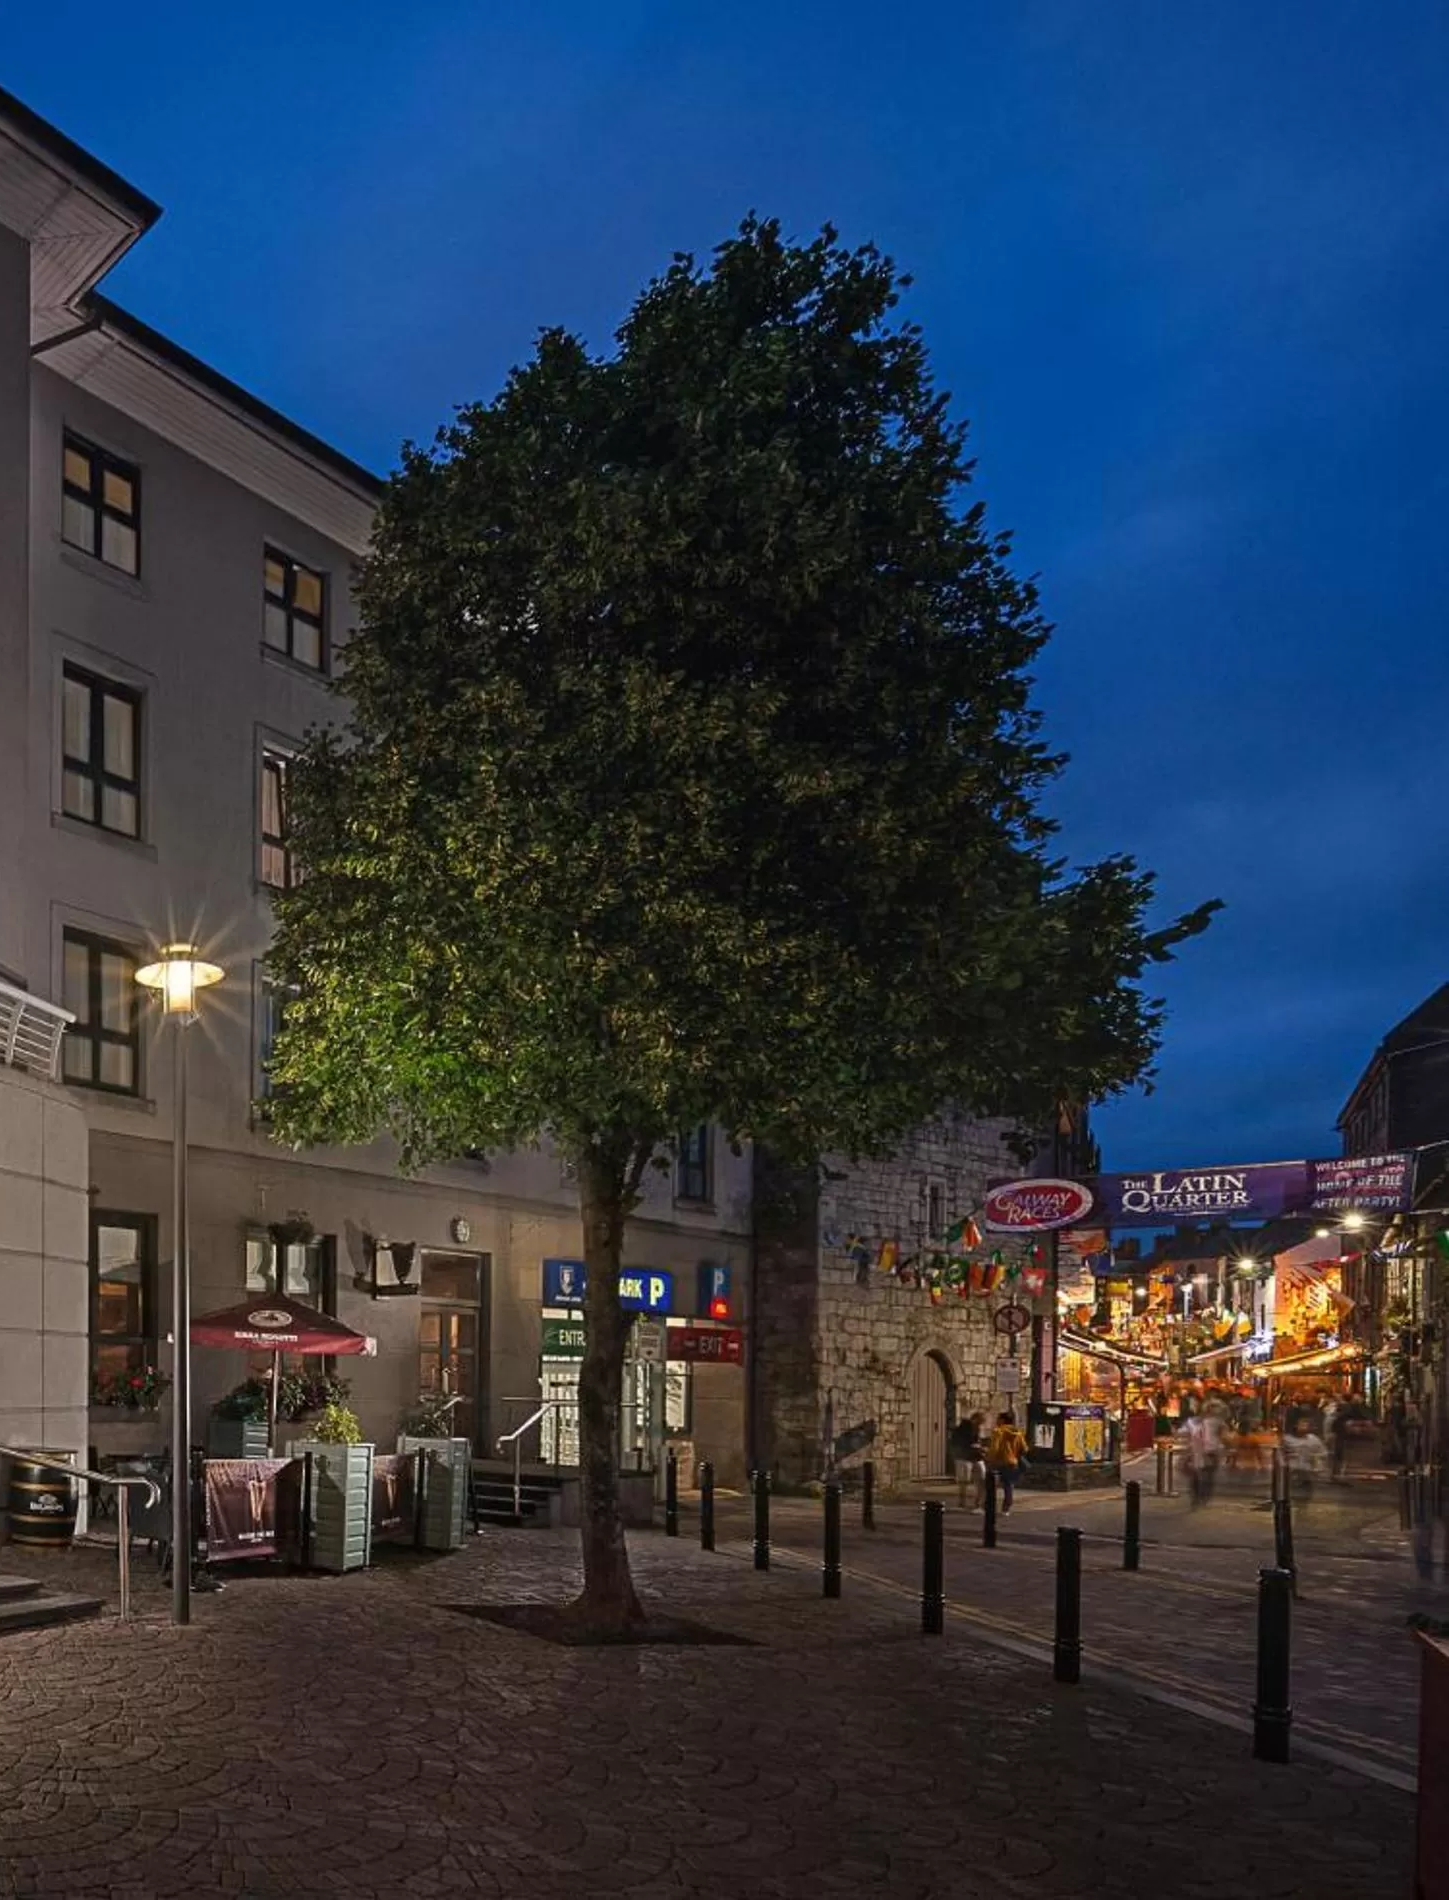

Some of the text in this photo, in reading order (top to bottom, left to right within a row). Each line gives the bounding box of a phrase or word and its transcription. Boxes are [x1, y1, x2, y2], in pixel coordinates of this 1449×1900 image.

[1314, 1158, 1367, 1172] WELCOME
[1121, 1172, 1247, 1194] THE LATIN
[995, 1191, 1073, 1210] GALWAY
[1121, 1189, 1252, 1213] QUARTER
[1007, 1204, 1061, 1224] RACES
[618, 1276, 644, 1299] ARK
[559, 1328, 586, 1347] ENTR
